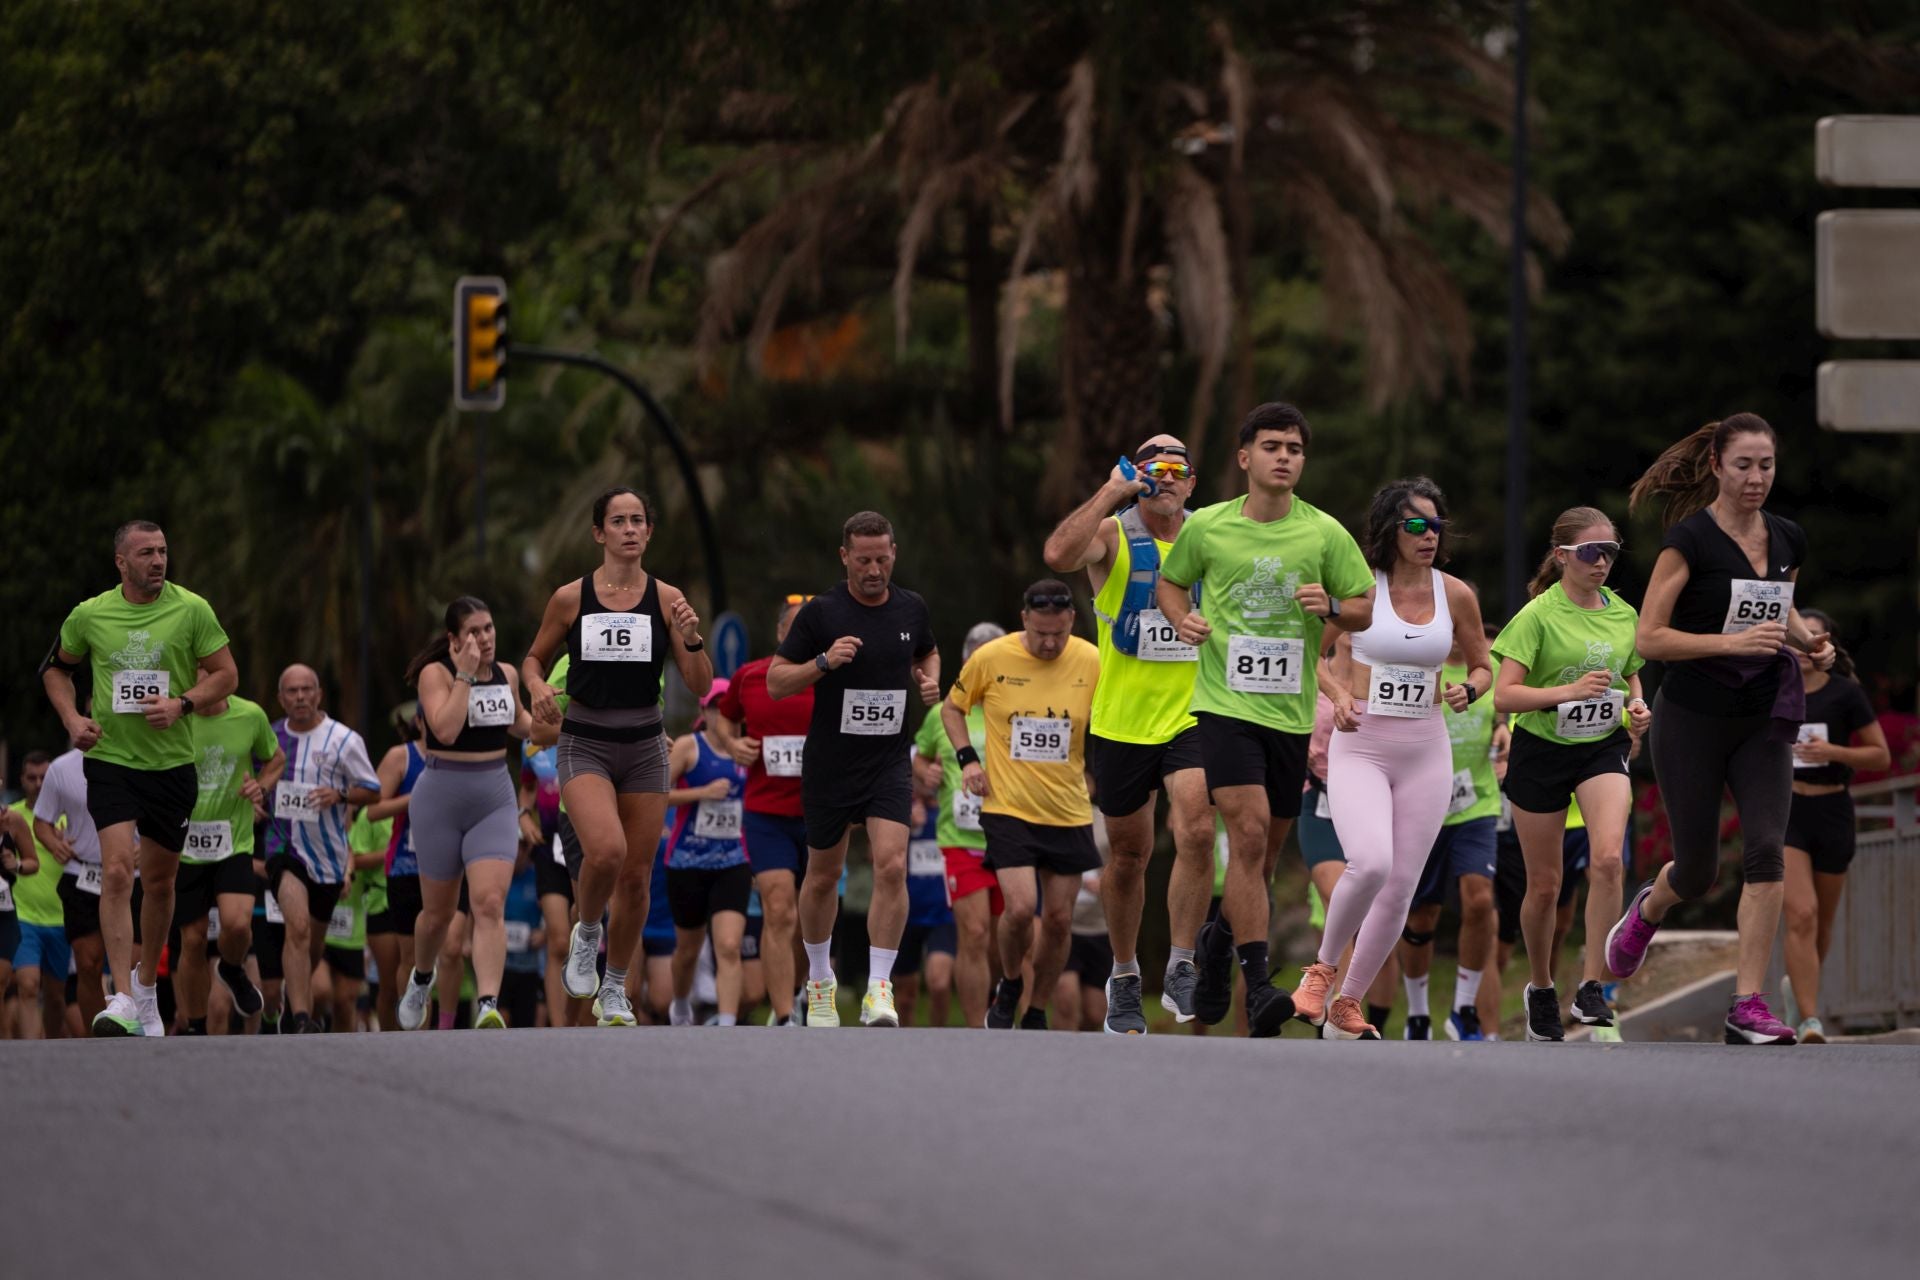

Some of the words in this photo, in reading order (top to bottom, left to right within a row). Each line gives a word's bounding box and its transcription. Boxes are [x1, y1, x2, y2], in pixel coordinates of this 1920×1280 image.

[1737, 600, 1782, 620] 639
[600, 629, 631, 646] 16
[1147, 626, 1181, 643] 10
[1237, 655, 1288, 676] 811
[121, 685, 160, 700] 569
[1379, 682, 1425, 702] 917
[476, 698, 508, 713] 134
[851, 705, 895, 721] 554
[1567, 702, 1613, 722] 478
[1020, 732, 1061, 748] 599
[705, 812, 737, 827] 723
[189, 834, 223, 849] 967
